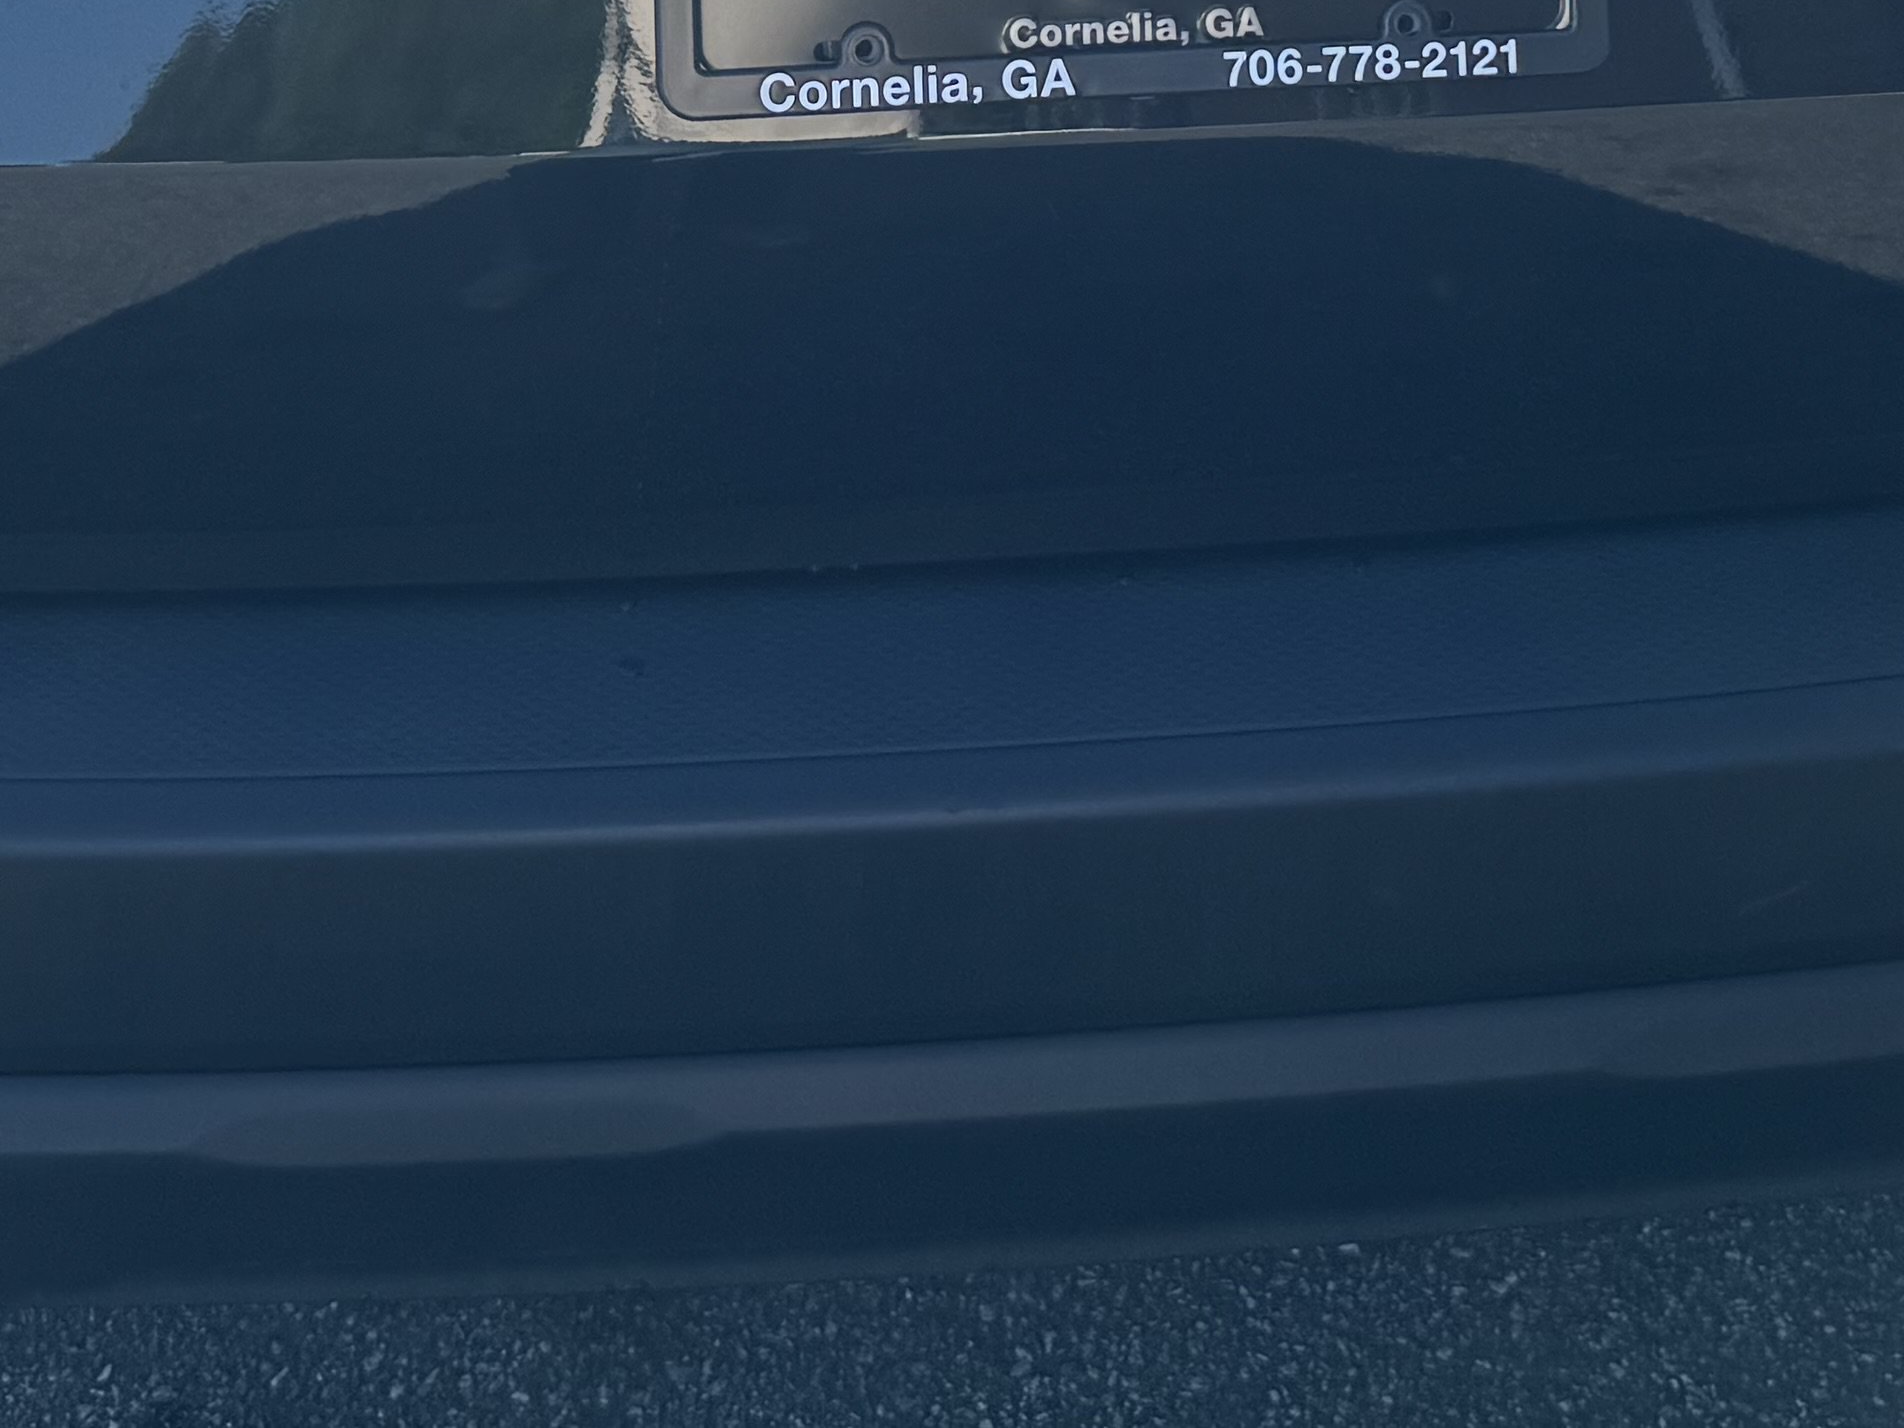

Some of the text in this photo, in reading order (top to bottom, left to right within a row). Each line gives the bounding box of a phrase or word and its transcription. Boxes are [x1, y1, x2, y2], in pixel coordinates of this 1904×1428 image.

[1007, 5, 1266, 50] Cornelia, GA
[759, 57, 1077, 114] Cornelia, GA
[1222, 38, 1518, 88] 706-778-2121
